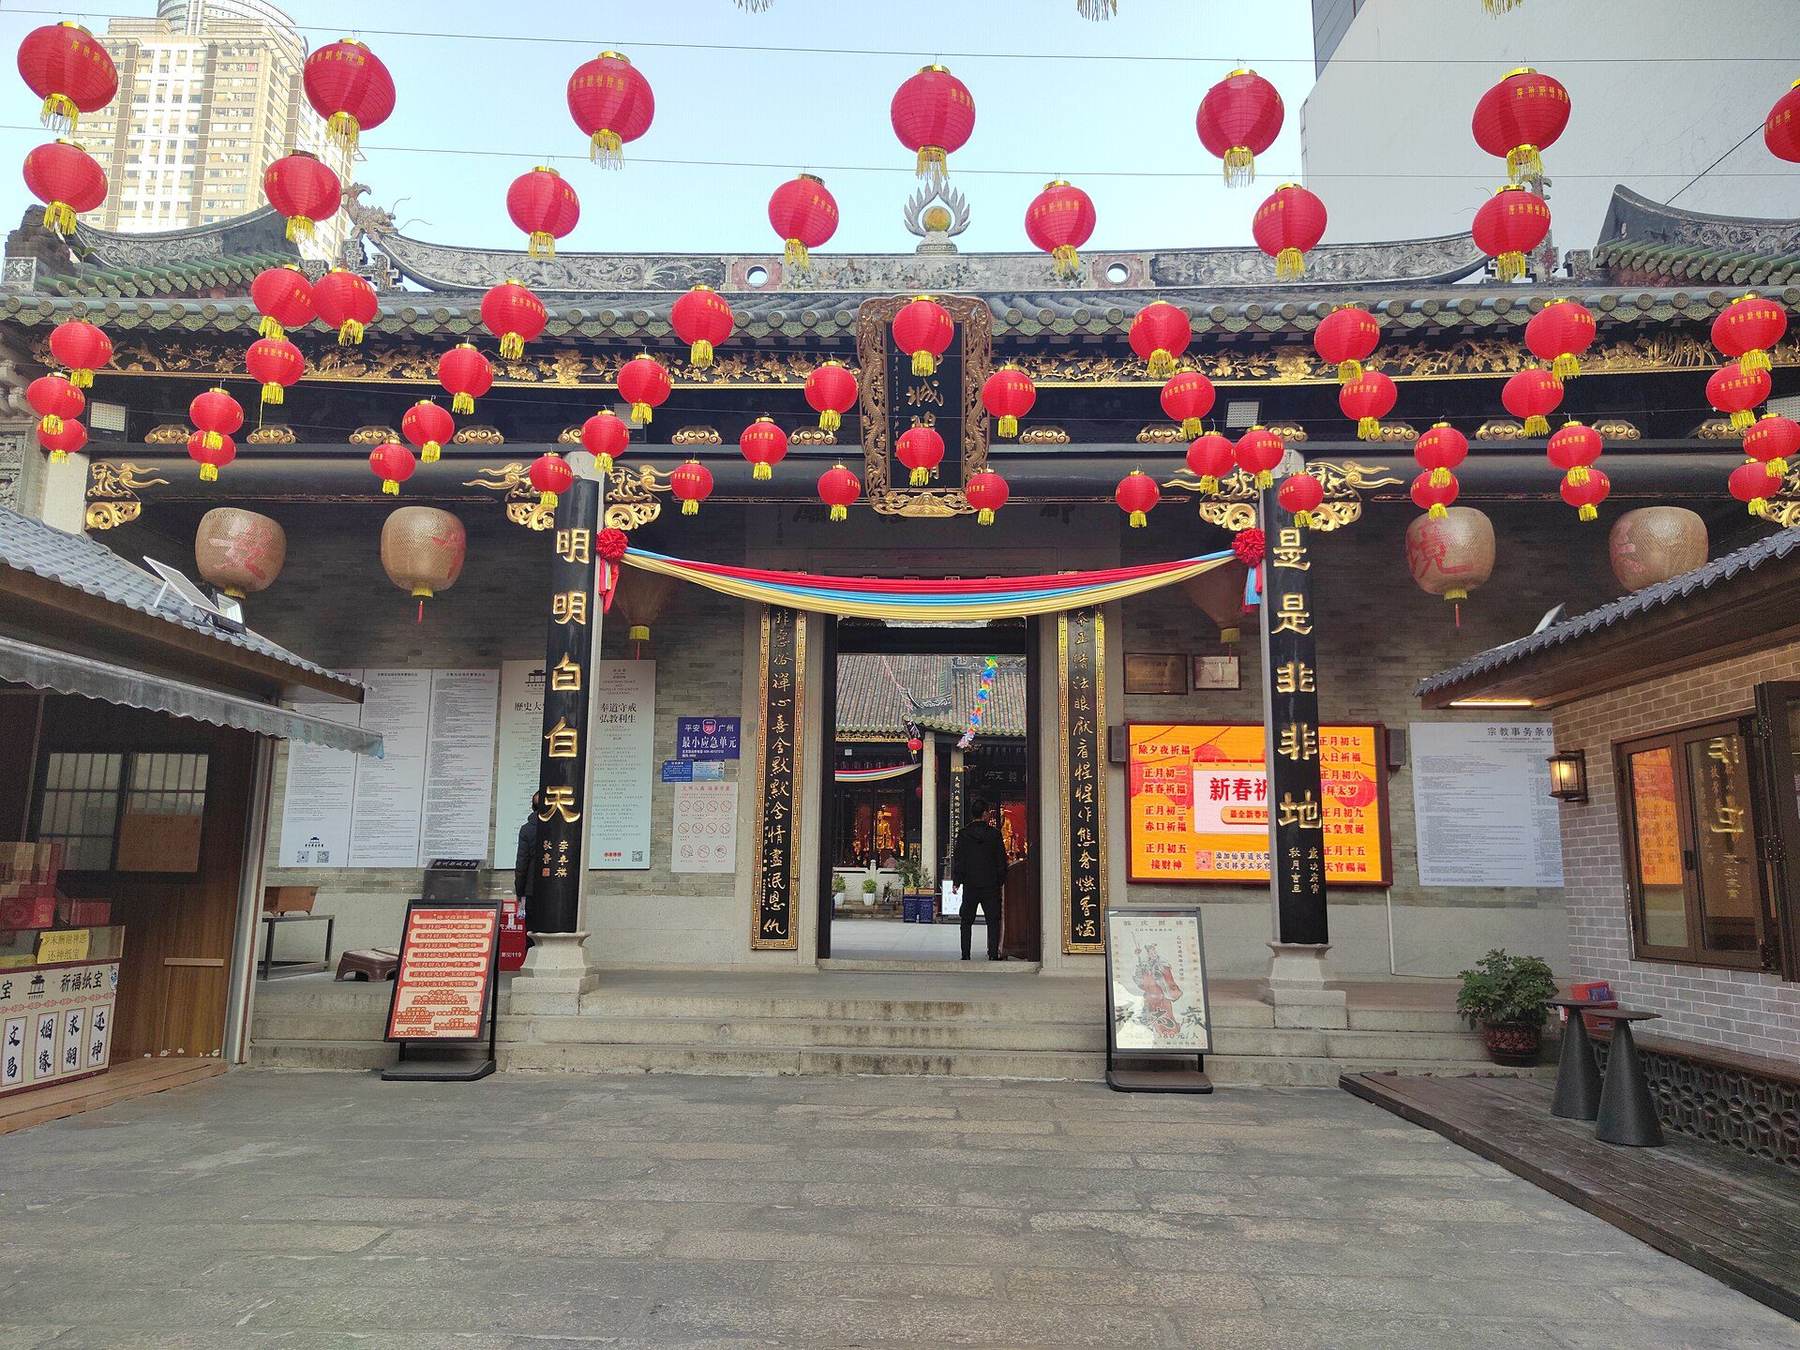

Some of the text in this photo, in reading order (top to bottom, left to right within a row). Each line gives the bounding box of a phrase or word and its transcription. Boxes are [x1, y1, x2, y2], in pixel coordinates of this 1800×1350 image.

[538, 528, 590, 823] 明明白白天
[514, 701, 545, 712] 歷史大
[684, 724, 734, 733] 平安 广州
[682, 736, 737, 749] 最小应急单元
[1320, 737, 1361, 746] 正月初七
[1138, 744, 1191, 756] 除夕夜祈福
[1320, 752, 1361, 762] 人日祈福
[1144, 768, 1186, 778] 正月初一
[1321, 770, 1362, 780] 正月初八
[1145, 784, 1186, 794] 新春祈福
[1326, 786, 1358, 796] 拜太岁
[1145, 805, 1187, 816] 正月初三
[1322, 808, 1364, 818] 正月初九
[1145, 821, 1187, 832] 赤口祈福
[1145, 844, 1187, 854] 正月初五
[1324, 846, 1366, 856] 正月十五
[7, 1025, 21, 1079] 文昌
